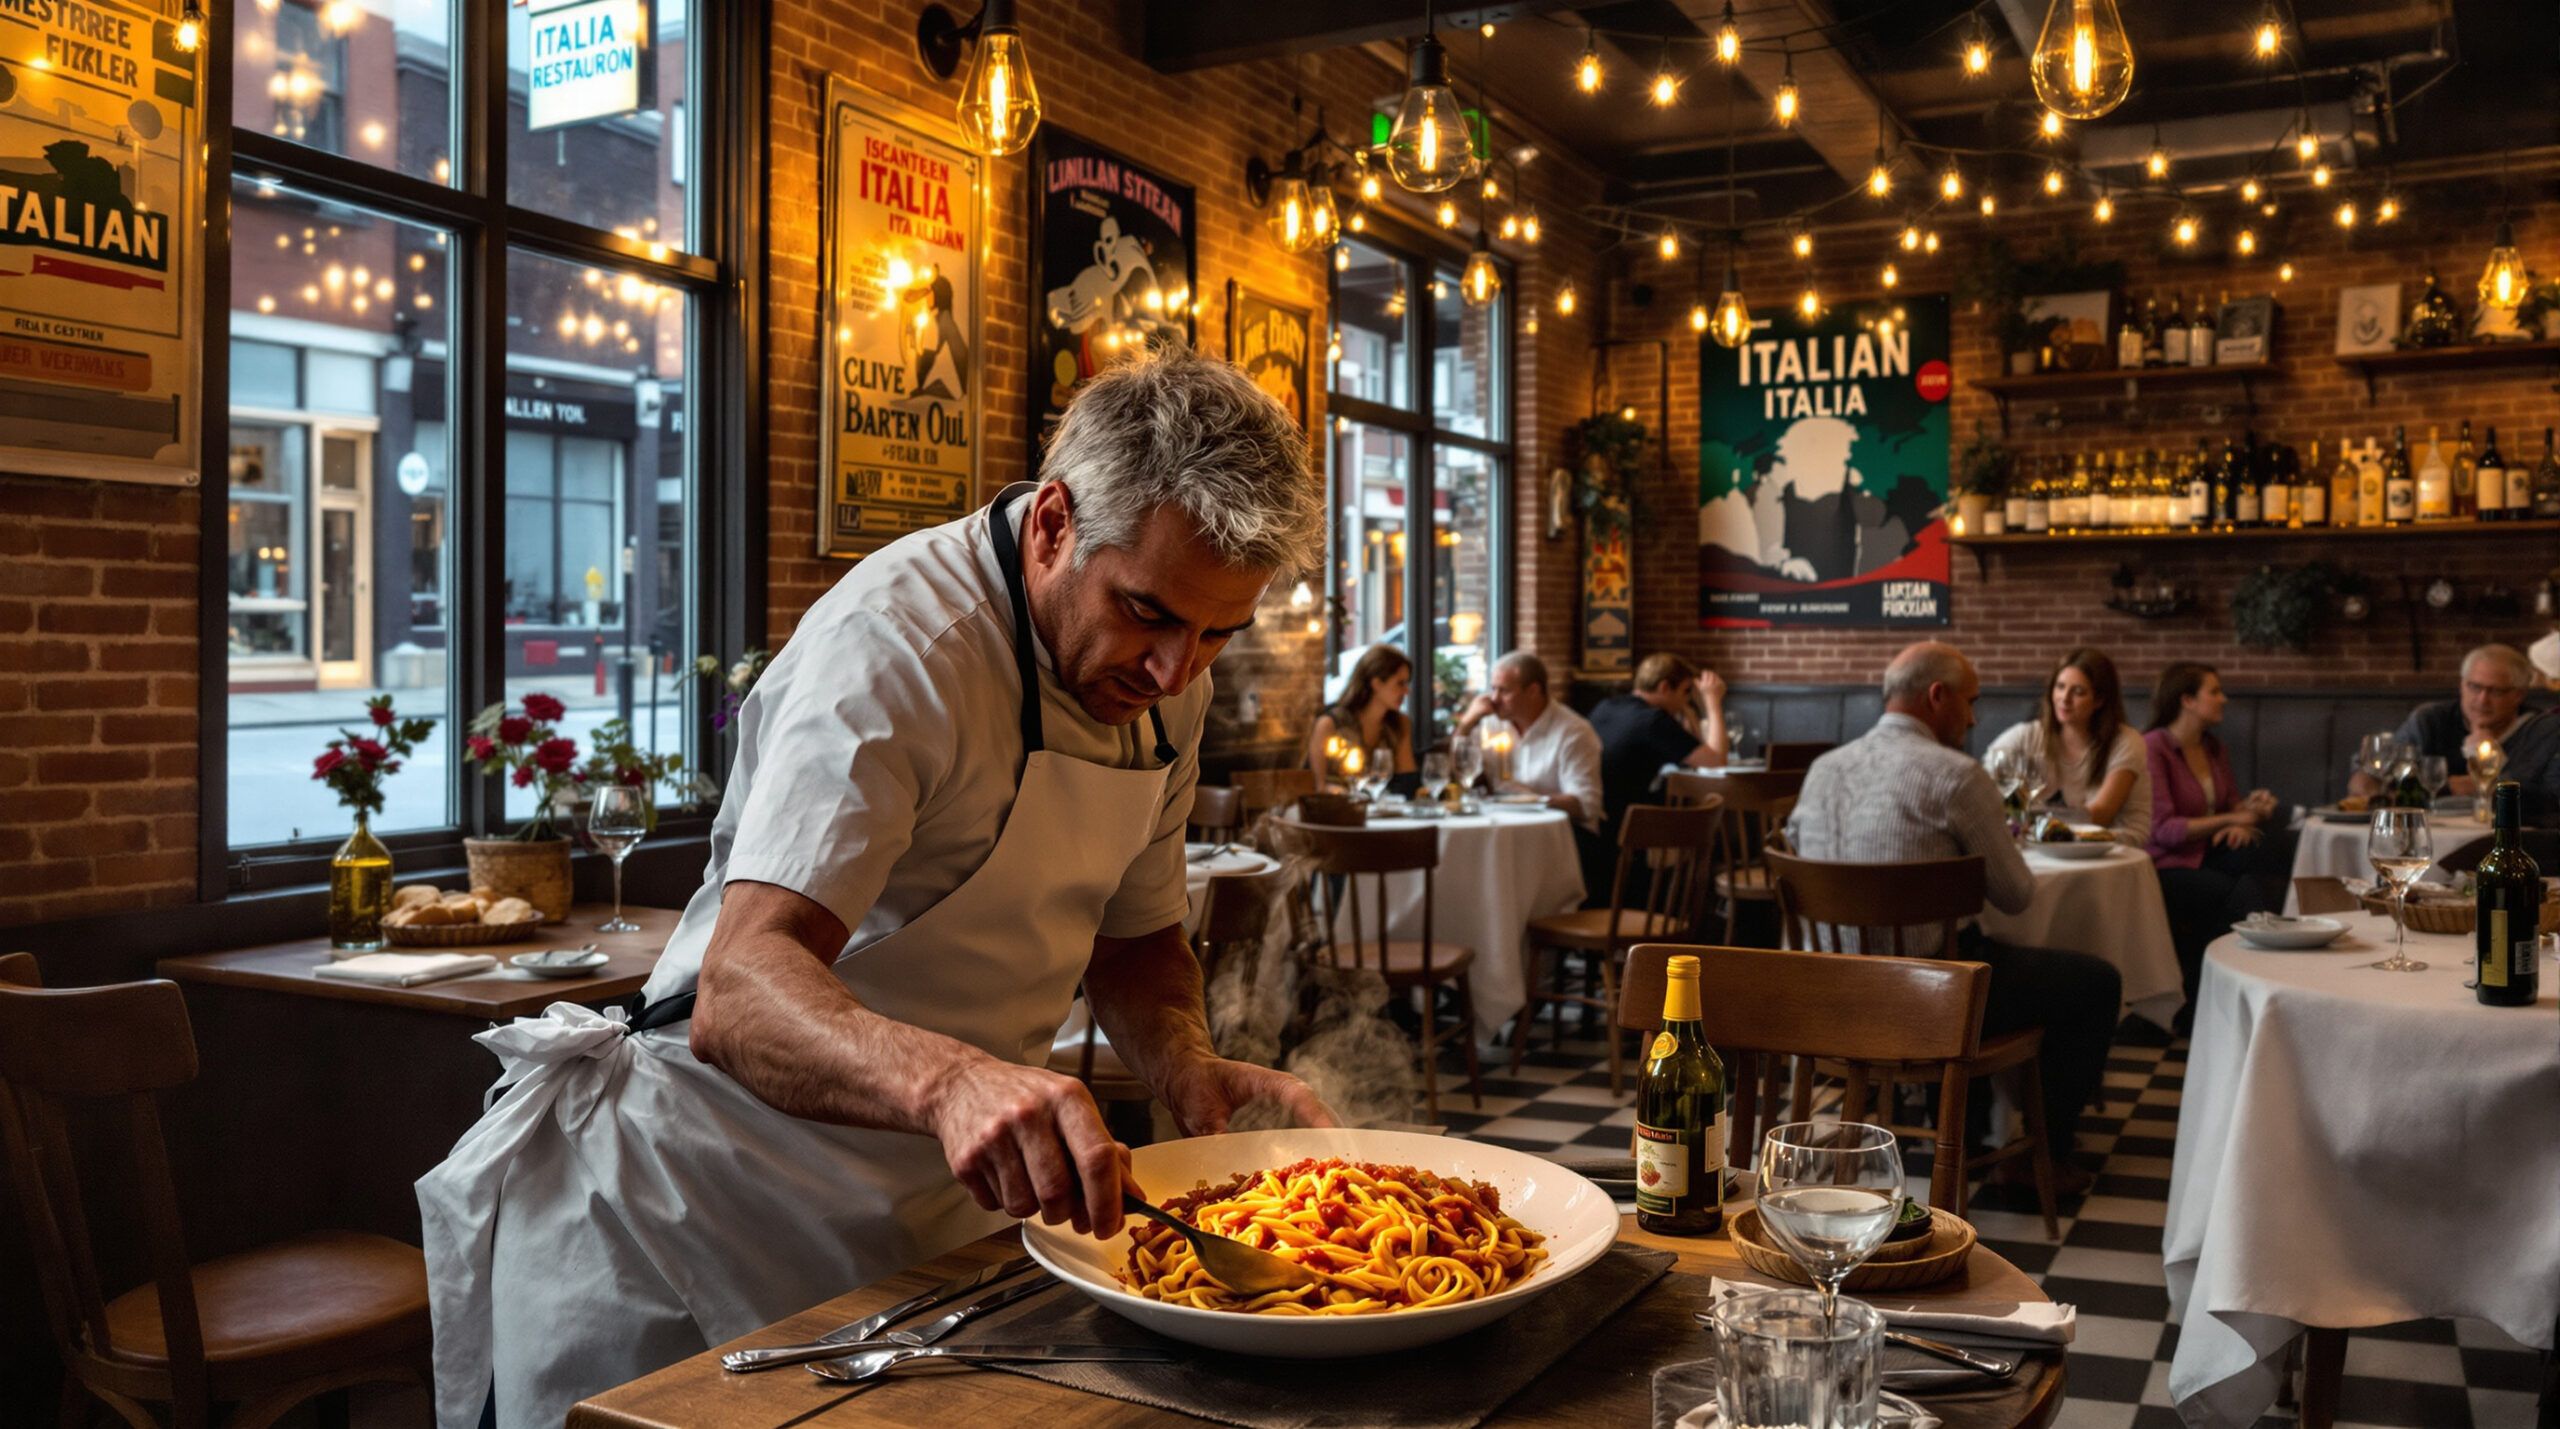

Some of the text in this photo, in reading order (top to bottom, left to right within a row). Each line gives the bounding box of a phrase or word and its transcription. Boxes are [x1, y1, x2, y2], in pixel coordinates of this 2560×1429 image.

[536, 14, 615, 58] ITALIA
[533, 46, 632, 89] RESTAURON
[860, 159, 952, 226] ITALIA
[844, 357, 905, 394] CLIVE
[1739, 330, 1910, 386] ITALIAN
[1765, 383, 1867, 420] ITALIA
